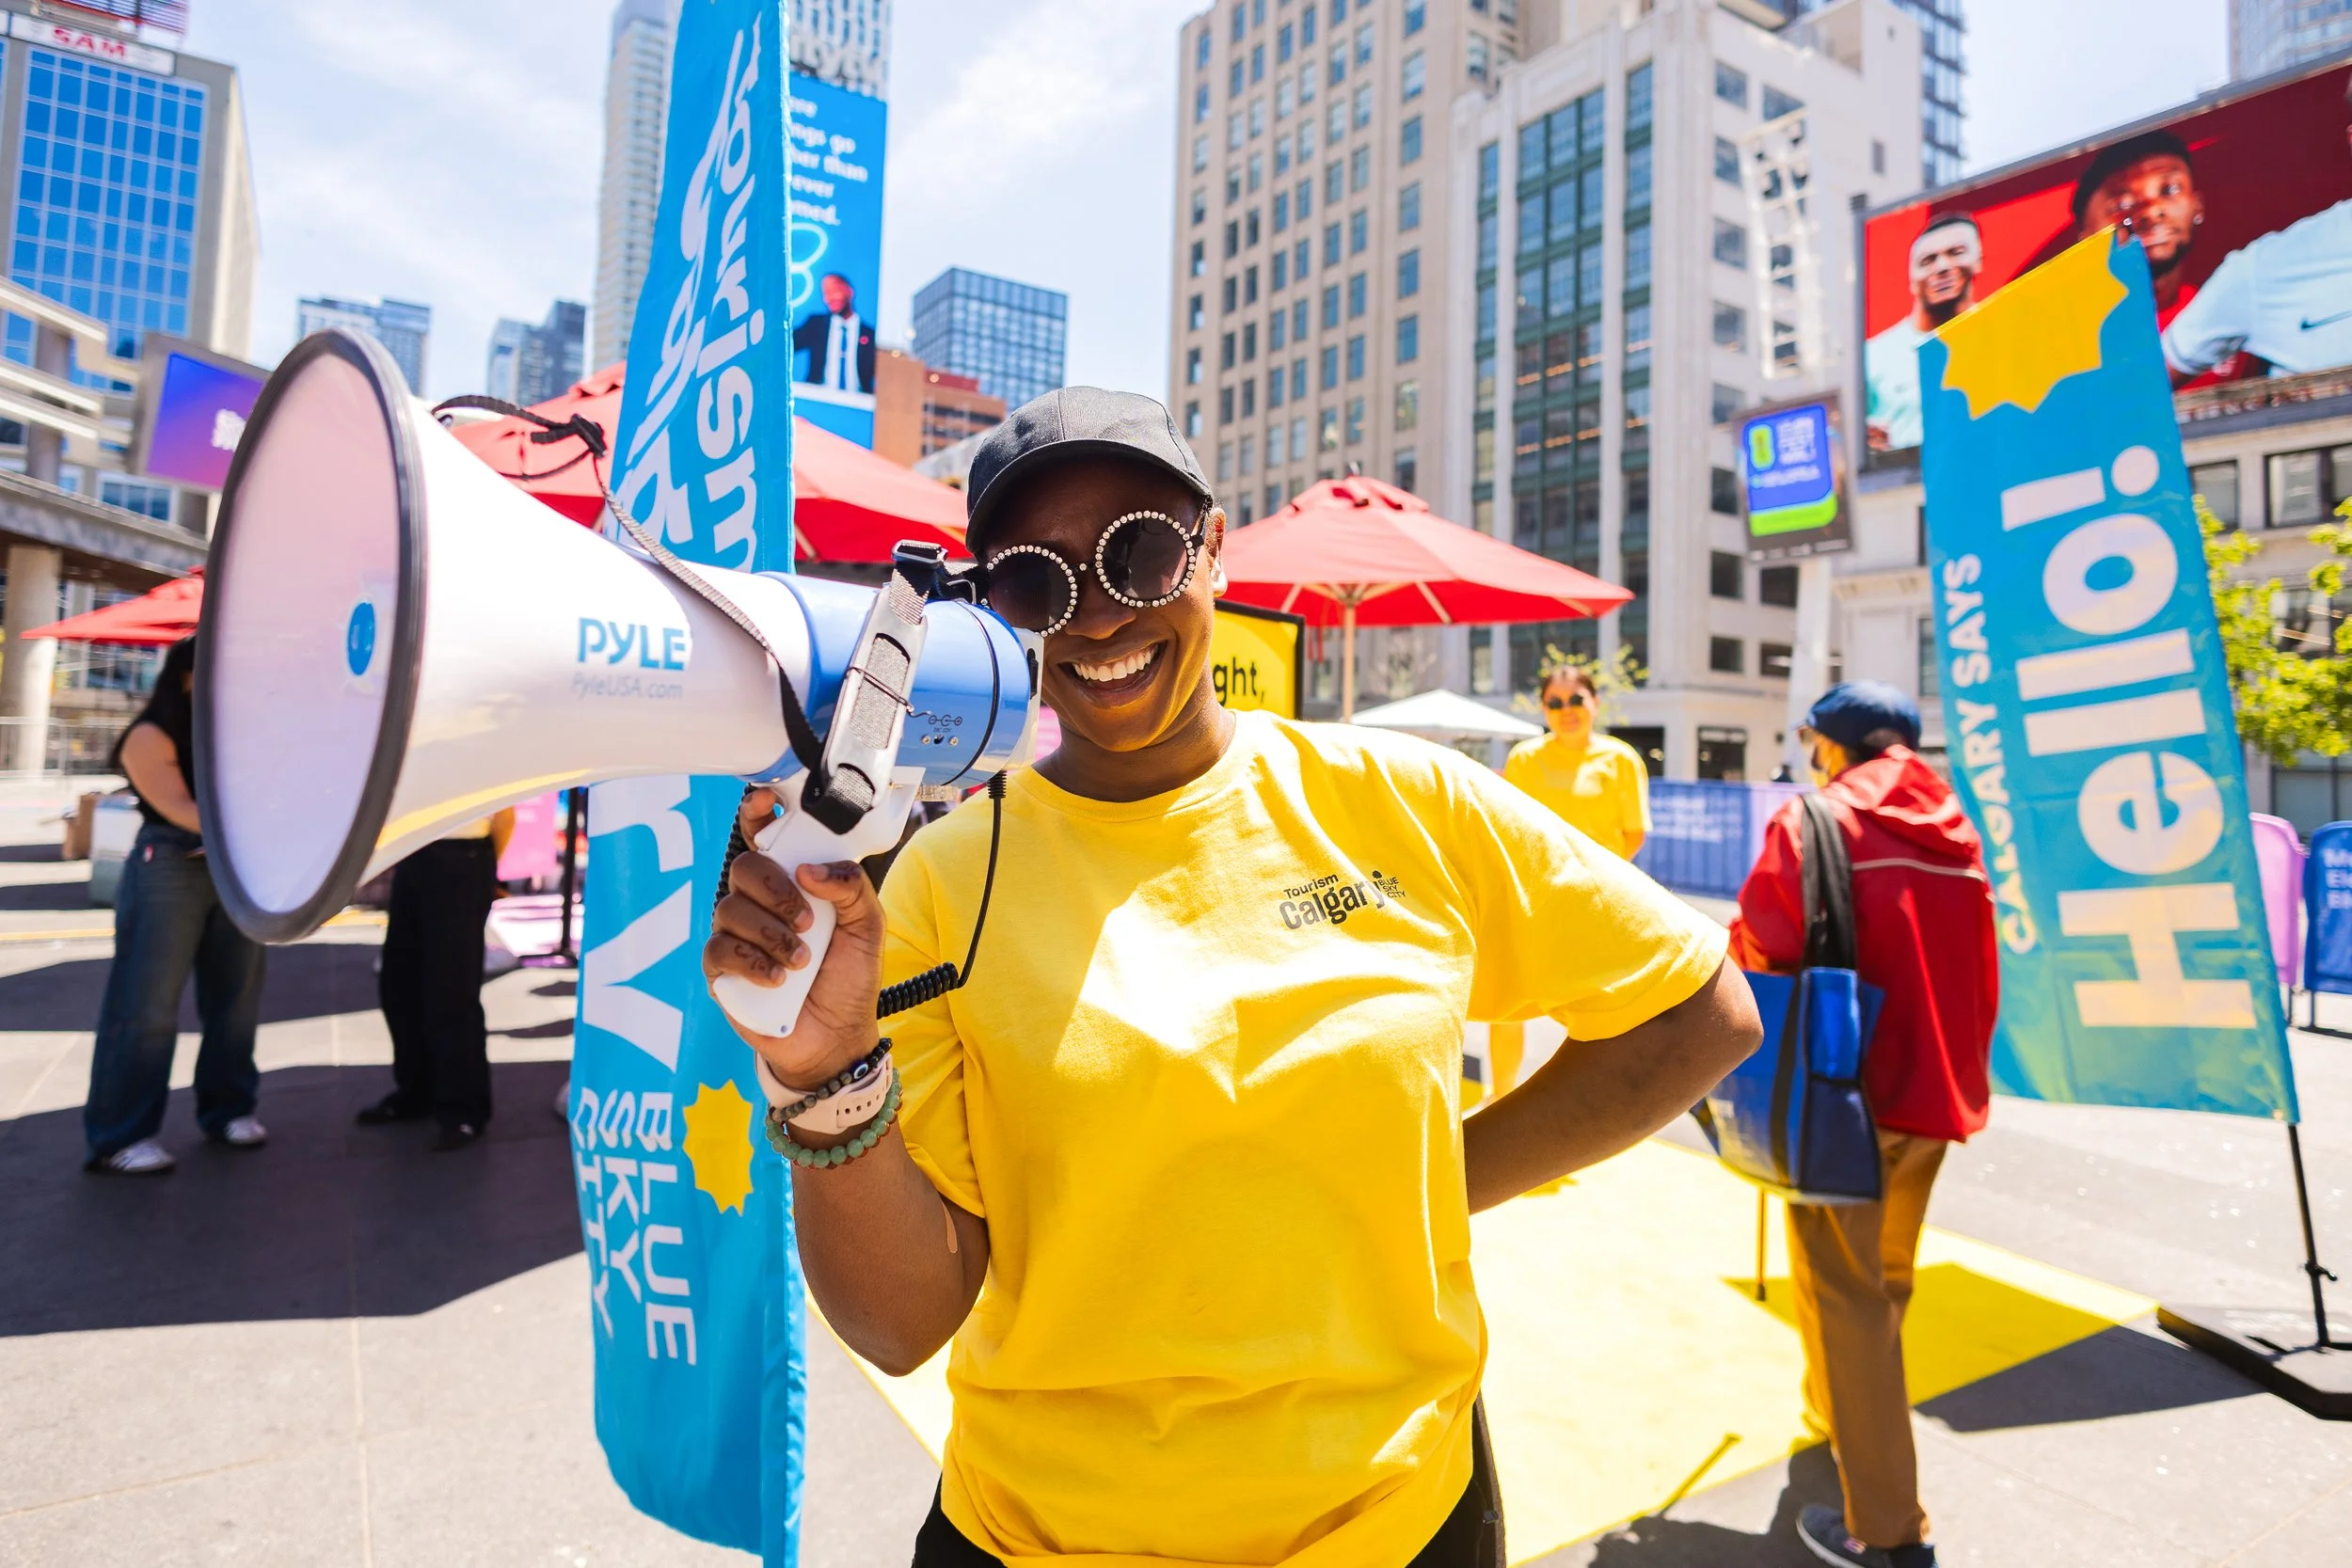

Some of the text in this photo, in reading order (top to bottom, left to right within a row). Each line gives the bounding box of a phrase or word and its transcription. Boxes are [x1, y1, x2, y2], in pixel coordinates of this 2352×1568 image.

[53, 26, 127, 58] SAM
[789, 96, 818, 119] ere
[789, 122, 856, 155] ngs go
[789, 143, 868, 182] her than
[578, 617, 686, 671] PYLE
[570, 672, 685, 700] PyleUSA.com
[1213, 657, 1264, 706] ght,
[1943, 553, 2037, 954] CALGARY SAYS
[2000, 444, 2257, 1028] Hello!
[1279, 880, 1385, 930] Calgary
[1283, 874, 1339, 899] Tourism
[1378, 877, 1399, 886] BLUE
[571, 1085, 613, 1338] CITY
[598, 1088, 642, 1305] SKY
[635, 1091, 697, 1366] BLUE
